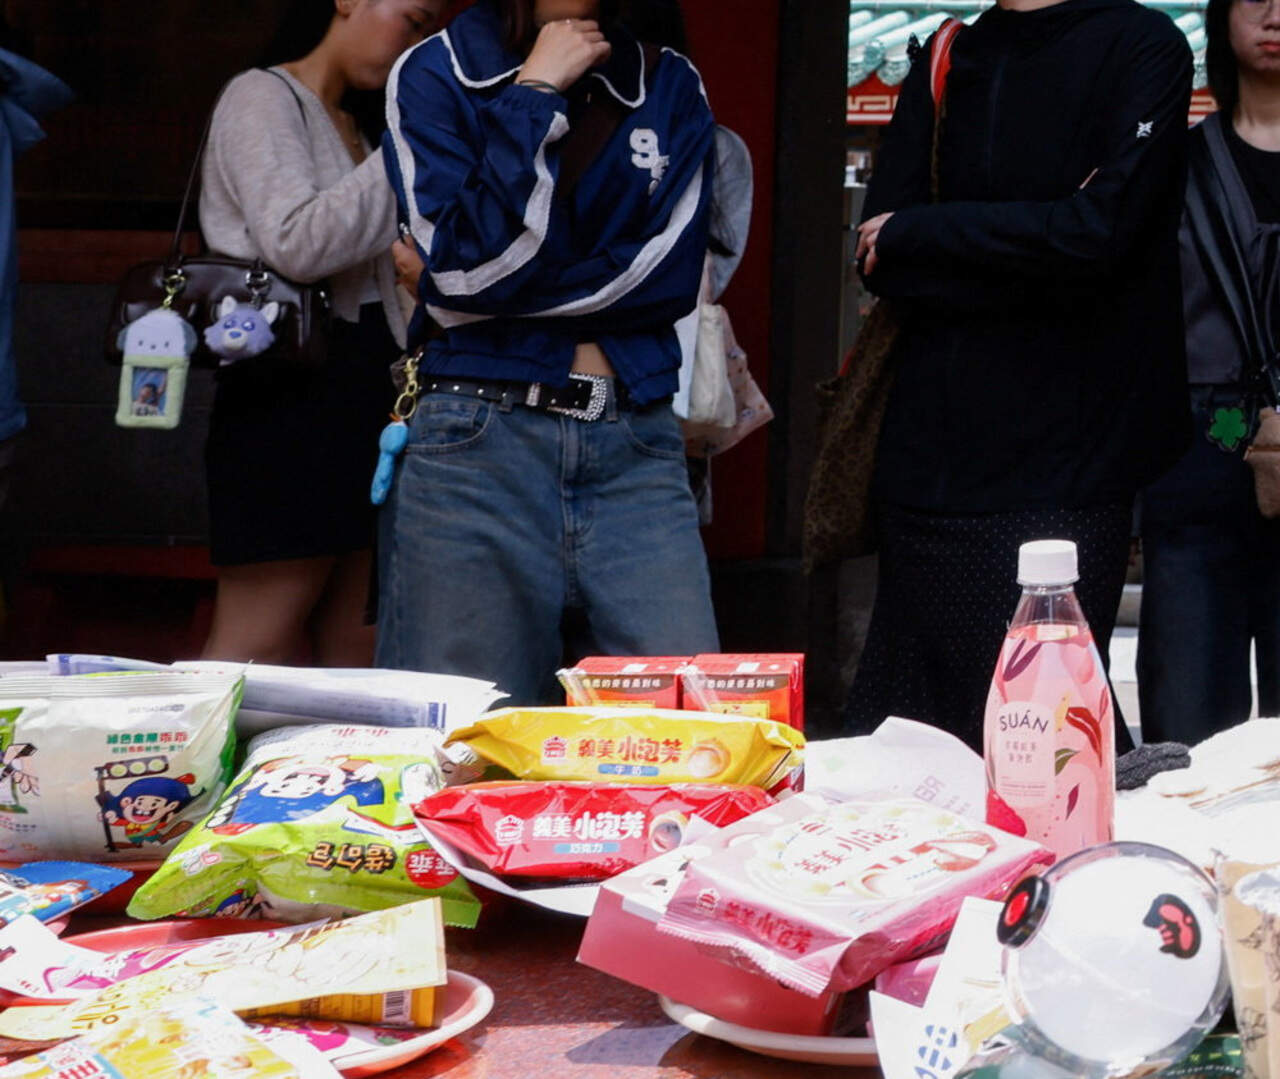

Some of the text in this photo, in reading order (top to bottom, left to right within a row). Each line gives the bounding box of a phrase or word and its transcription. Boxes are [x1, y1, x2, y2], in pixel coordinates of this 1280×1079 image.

[999, 709, 1049, 734] SUÁN
[531, 810, 646, 842] 義美小泡芙
[568, 842, 603, 855] 巧克力
